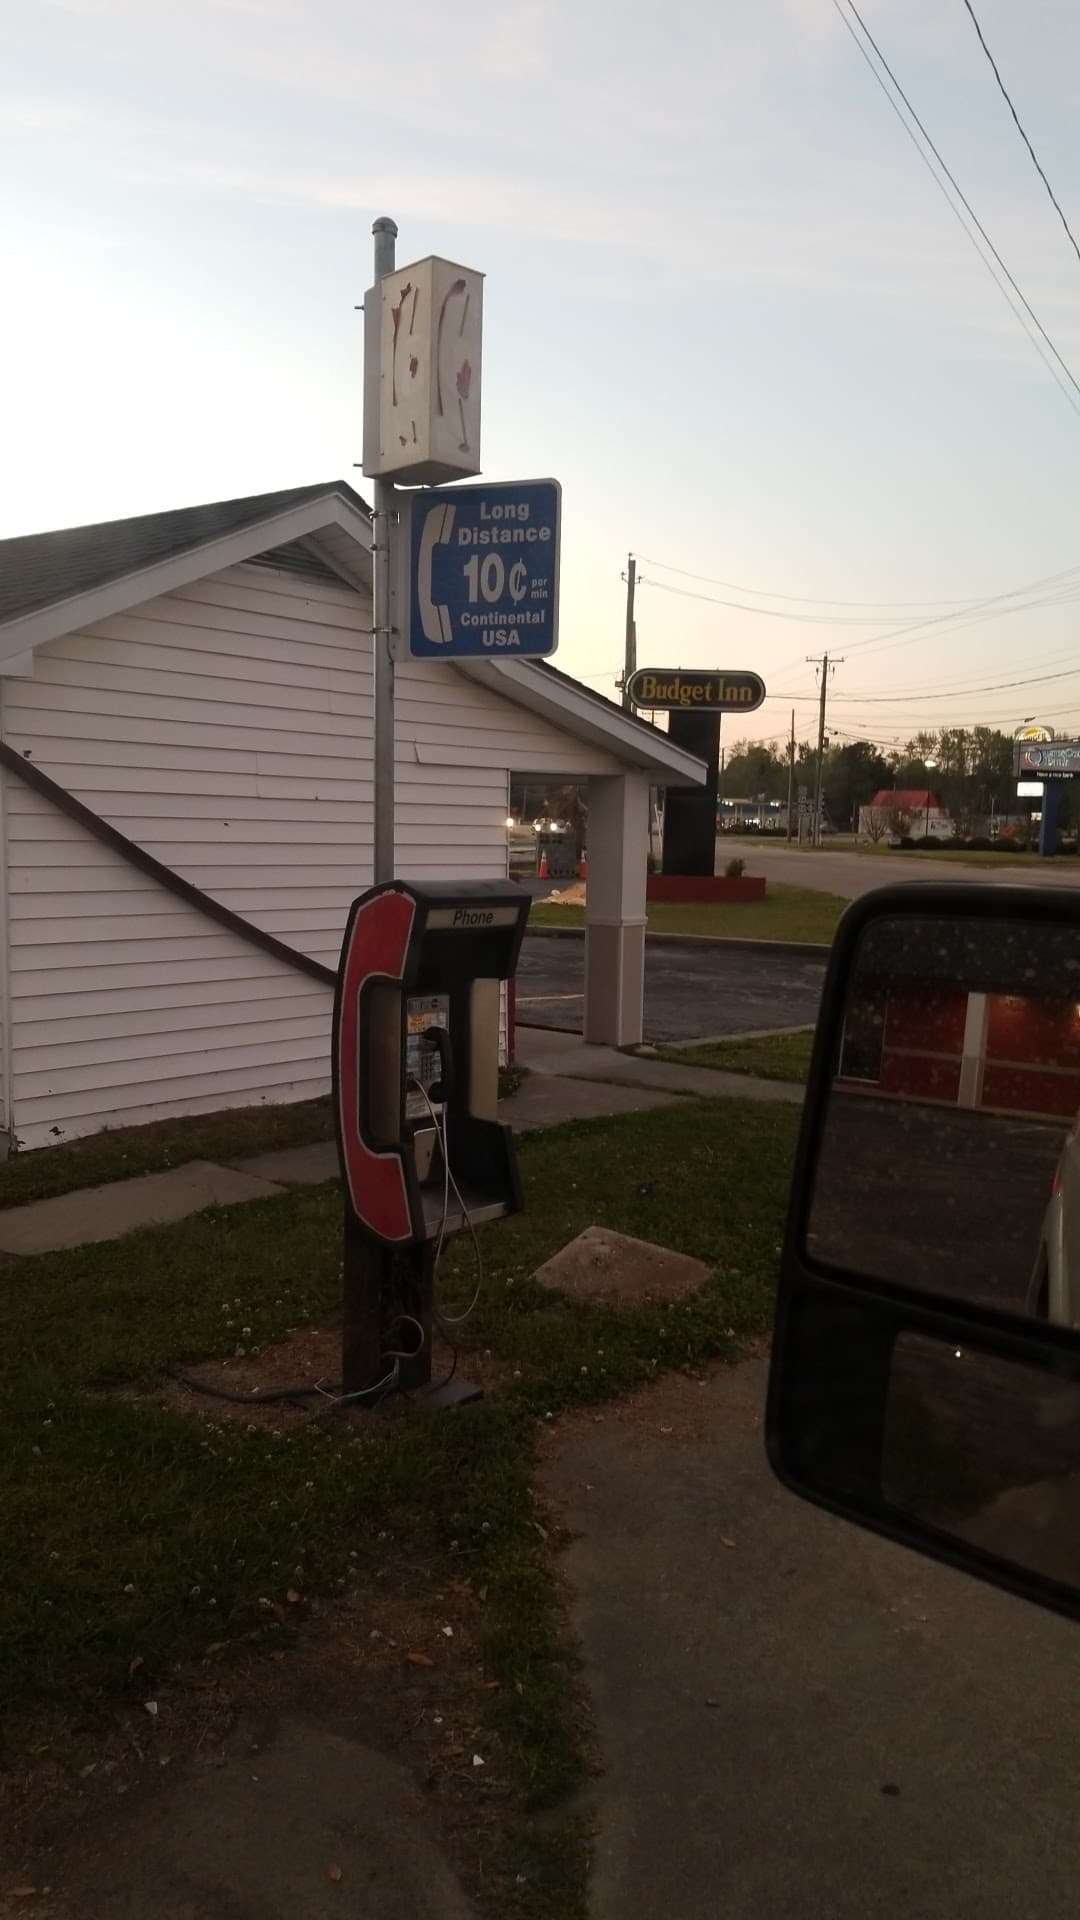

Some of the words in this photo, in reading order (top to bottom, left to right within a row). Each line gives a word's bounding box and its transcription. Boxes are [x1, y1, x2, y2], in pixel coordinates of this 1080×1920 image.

[480, 502, 530, 521] Long
[458, 526, 551, 546] Distance
[531, 589, 548, 599] min
[460, 610, 545, 627] Continental
[482, 630, 520, 647] USA
[641, 675, 712, 705] Budget
[718, 677, 753, 702] Inn
[452, 910, 494, 926] Phone
